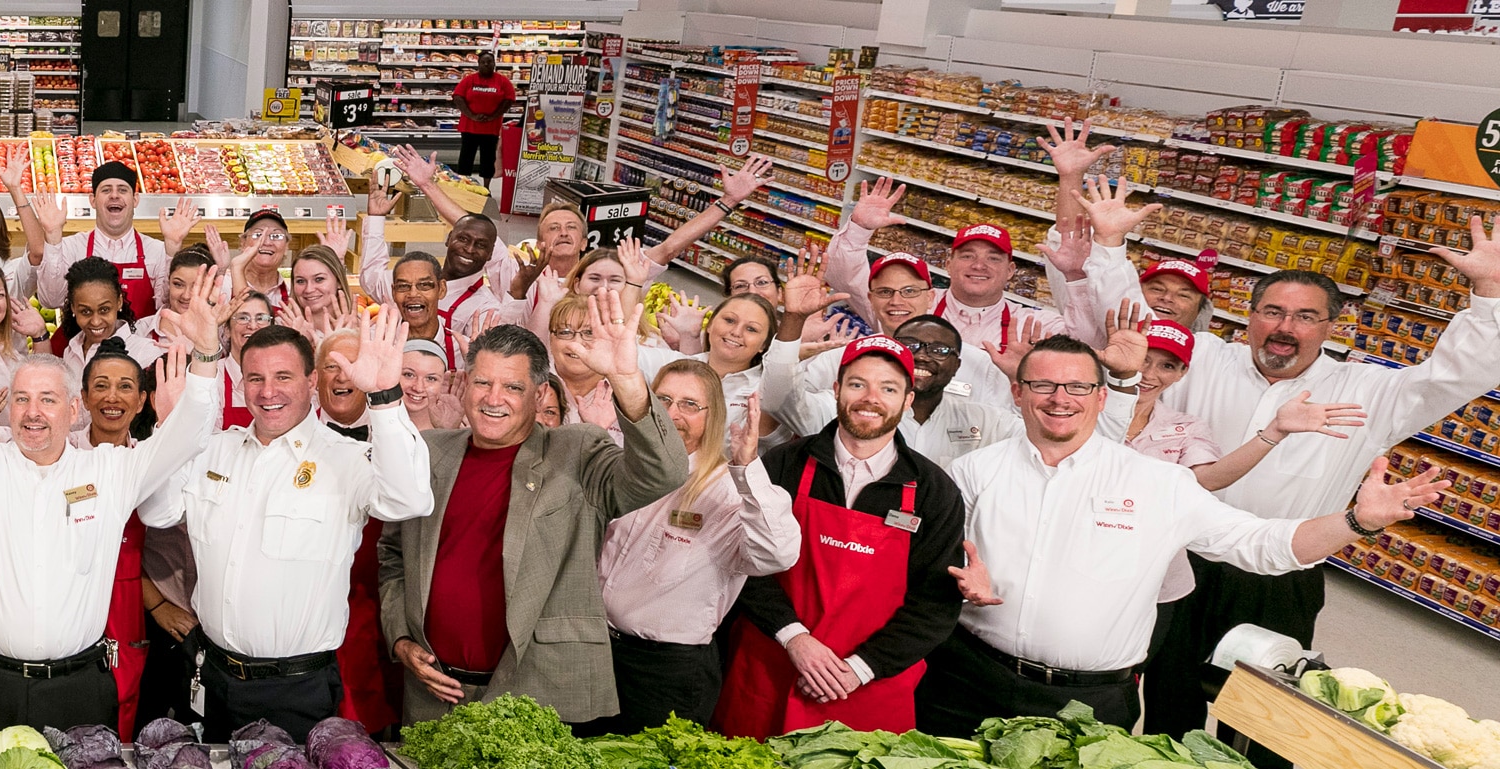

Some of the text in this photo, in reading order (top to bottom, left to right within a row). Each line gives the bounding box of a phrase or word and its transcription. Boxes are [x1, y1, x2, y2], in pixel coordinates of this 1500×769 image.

[531, 64, 589, 84] DEMAND MORE
[530, 82, 545, 91] FROM
[545, 83, 558, 92] YOUR
[558, 83, 568, 92] HOT
[835, 84, 858, 92] DOWN
[348, 91, 361, 99] sale
[607, 203, 630, 219] sale
